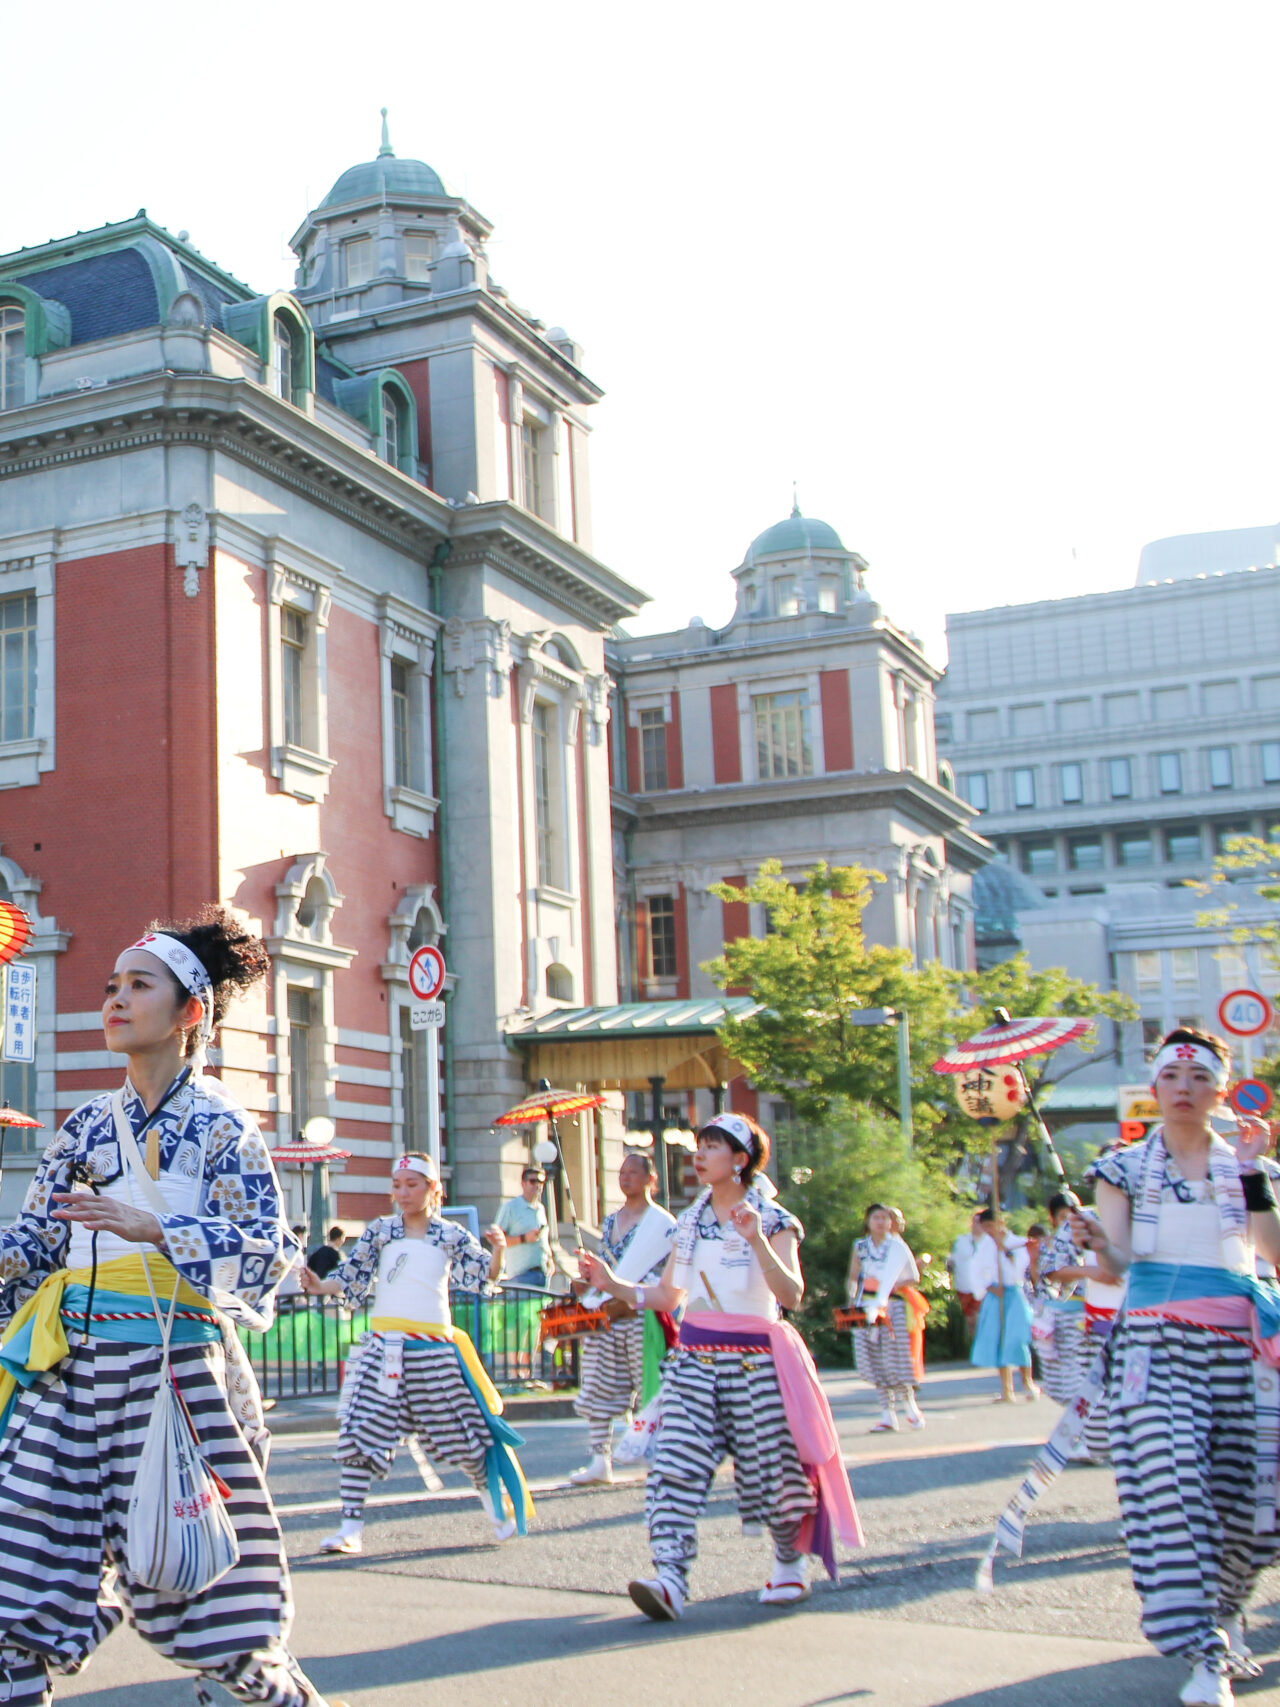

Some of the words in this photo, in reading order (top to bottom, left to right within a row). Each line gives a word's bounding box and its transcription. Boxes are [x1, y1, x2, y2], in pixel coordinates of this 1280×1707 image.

[9, 969, 20, 1018] 自転車
[20, 970, 31, 1021] 歩行者
[412, 1008, 442, 1025] ここから
[1231, 1003, 1261, 1023] 40
[13, 1022, 24, 1055] 専用
[1120, 1121, 1146, 1145] P
